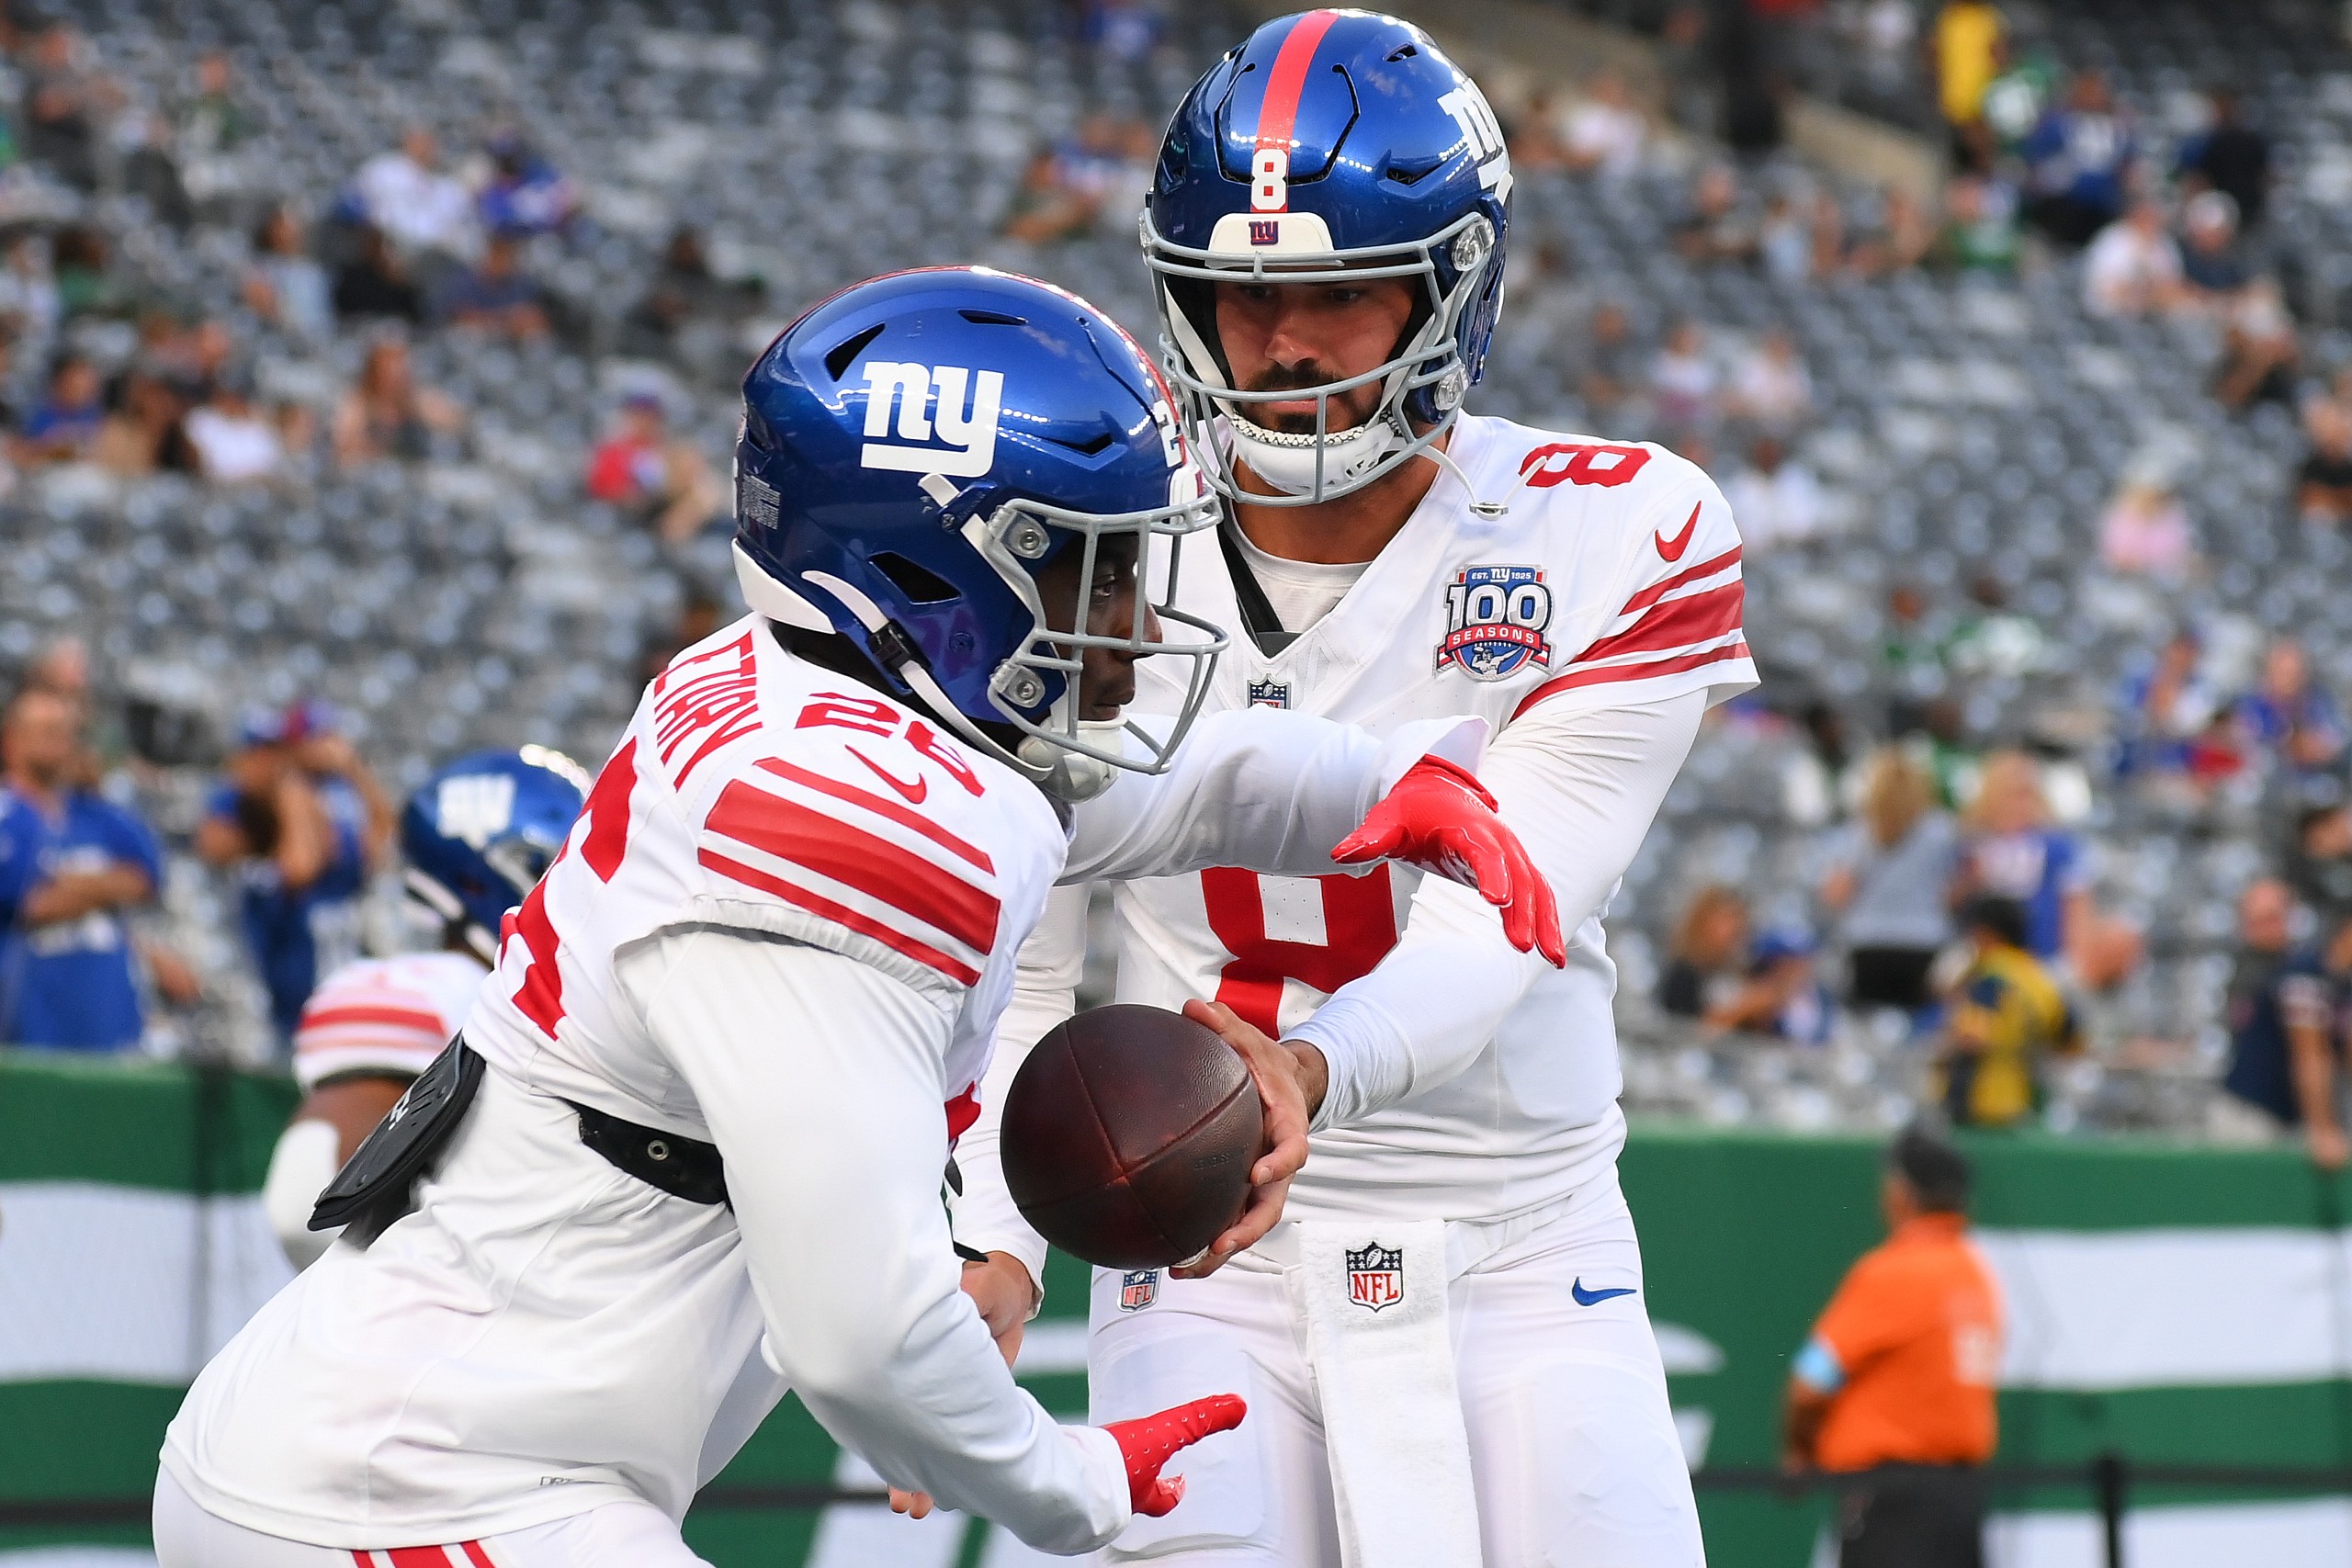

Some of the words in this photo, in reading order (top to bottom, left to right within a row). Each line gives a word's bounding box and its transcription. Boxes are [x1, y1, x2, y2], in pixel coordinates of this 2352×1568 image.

[1251, 149, 1287, 210] 8
[1249, 220, 1279, 246] ny
[861, 361, 1004, 478] ny
[1519, 442, 1652, 488] 8
[1471, 571, 1488, 581] EST.
[1511, 571, 1532, 581] 1925
[1447, 583, 1551, 634] 100
[1452, 626, 1535, 646] SEASONS
[1124, 1284, 1152, 1305] NFL
[1351, 1272, 1399, 1304] NFL
